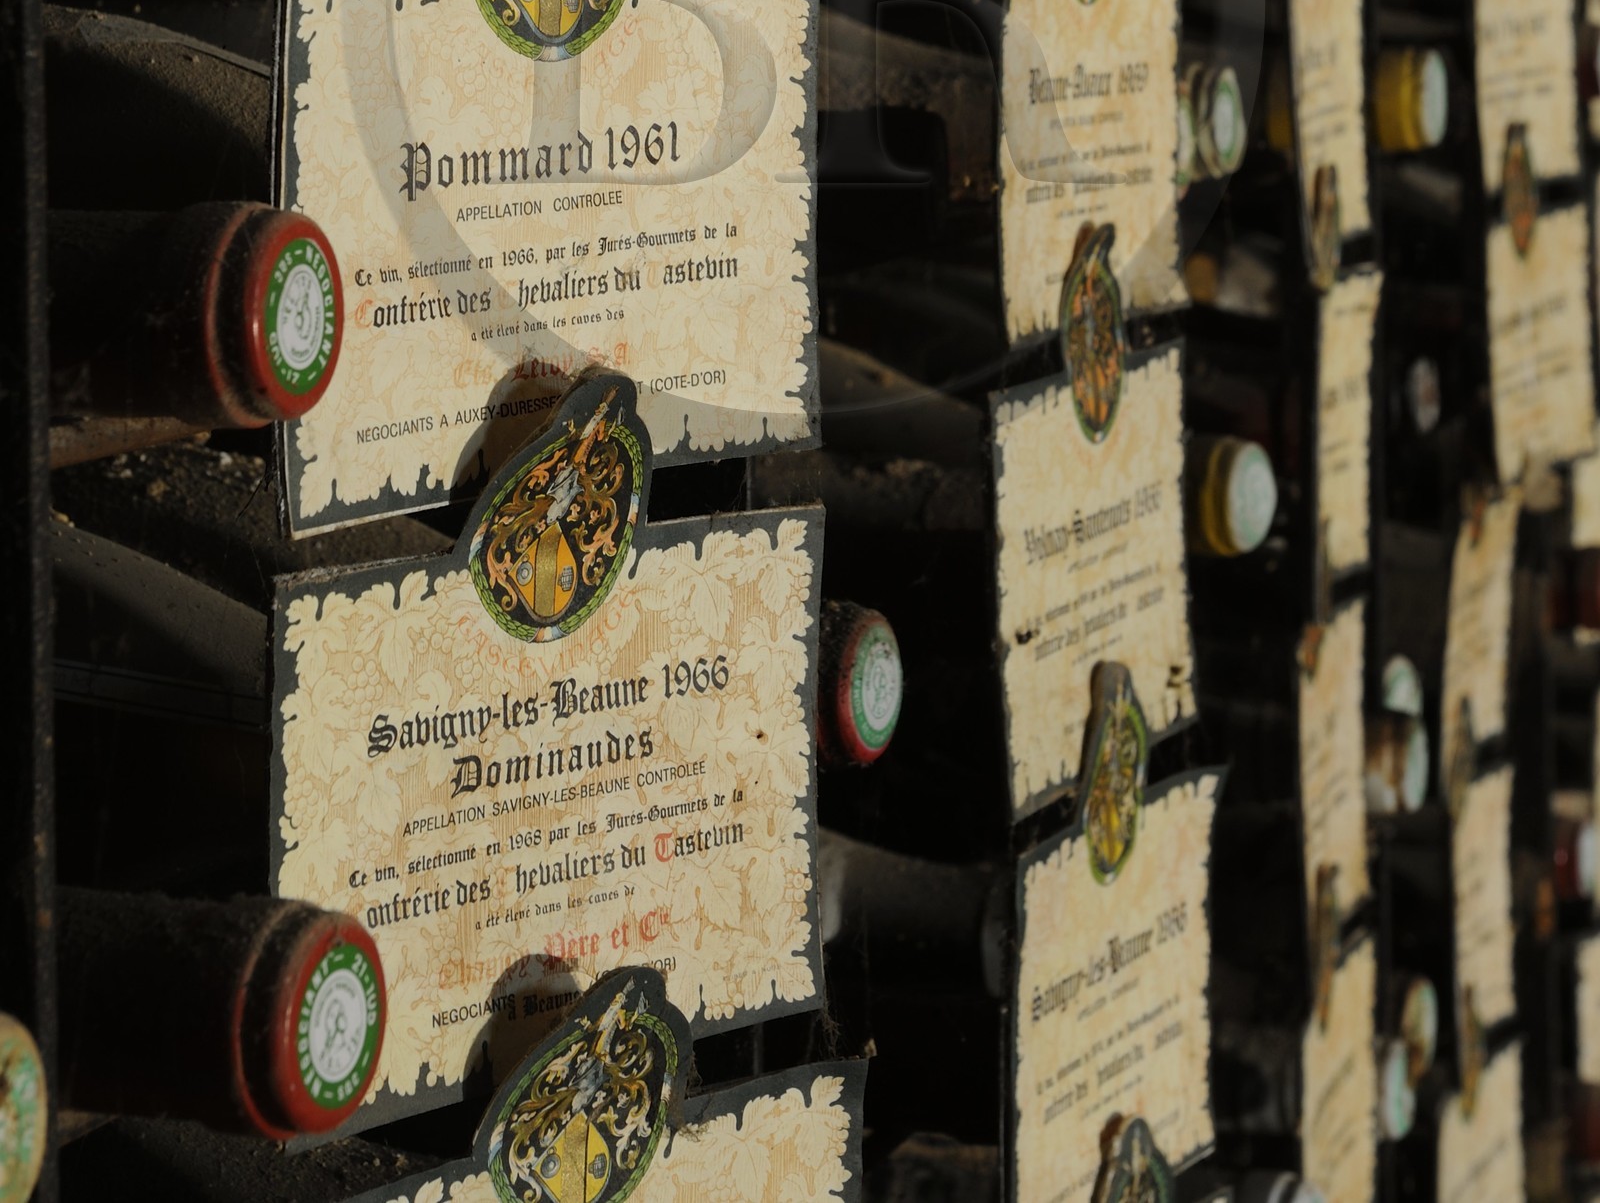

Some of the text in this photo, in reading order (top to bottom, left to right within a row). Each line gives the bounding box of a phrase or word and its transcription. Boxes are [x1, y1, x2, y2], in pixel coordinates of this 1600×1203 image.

[399, 121, 680, 202] Pommard 1961
[456, 200, 542, 222] APPELLATION
[355, 222, 738, 287] Ce vin, sélectionné en 1966, par les Jurés-Gourmets de la
[354, 289, 453, 330] Confrérie
[457, 287, 492, 316] des
[614, 266, 641, 293] du
[471, 309, 625, 341] a été élevé dans les caves des
[440, 414, 449, 428] A
[650, 369, 727, 395] (COTE-D'OR)
[367, 655, 730, 758] Savigny-les-Beaune 1966
[450, 726, 654, 799] Dominaudes
[349, 788, 743, 889] Ce vin, sélectionné en 1968 par les Jurés-Gourmets de la
[402, 804, 486, 837] APPELLATION
[492, 776, 631, 818] SAVIGNY-LES-BEAUNE
[366, 819, 744, 929] onfrérie des hevaliers du Tastevin
[475, 884, 636, 931] a été élevé dans les caves de
[611, 920, 630, 950] et
